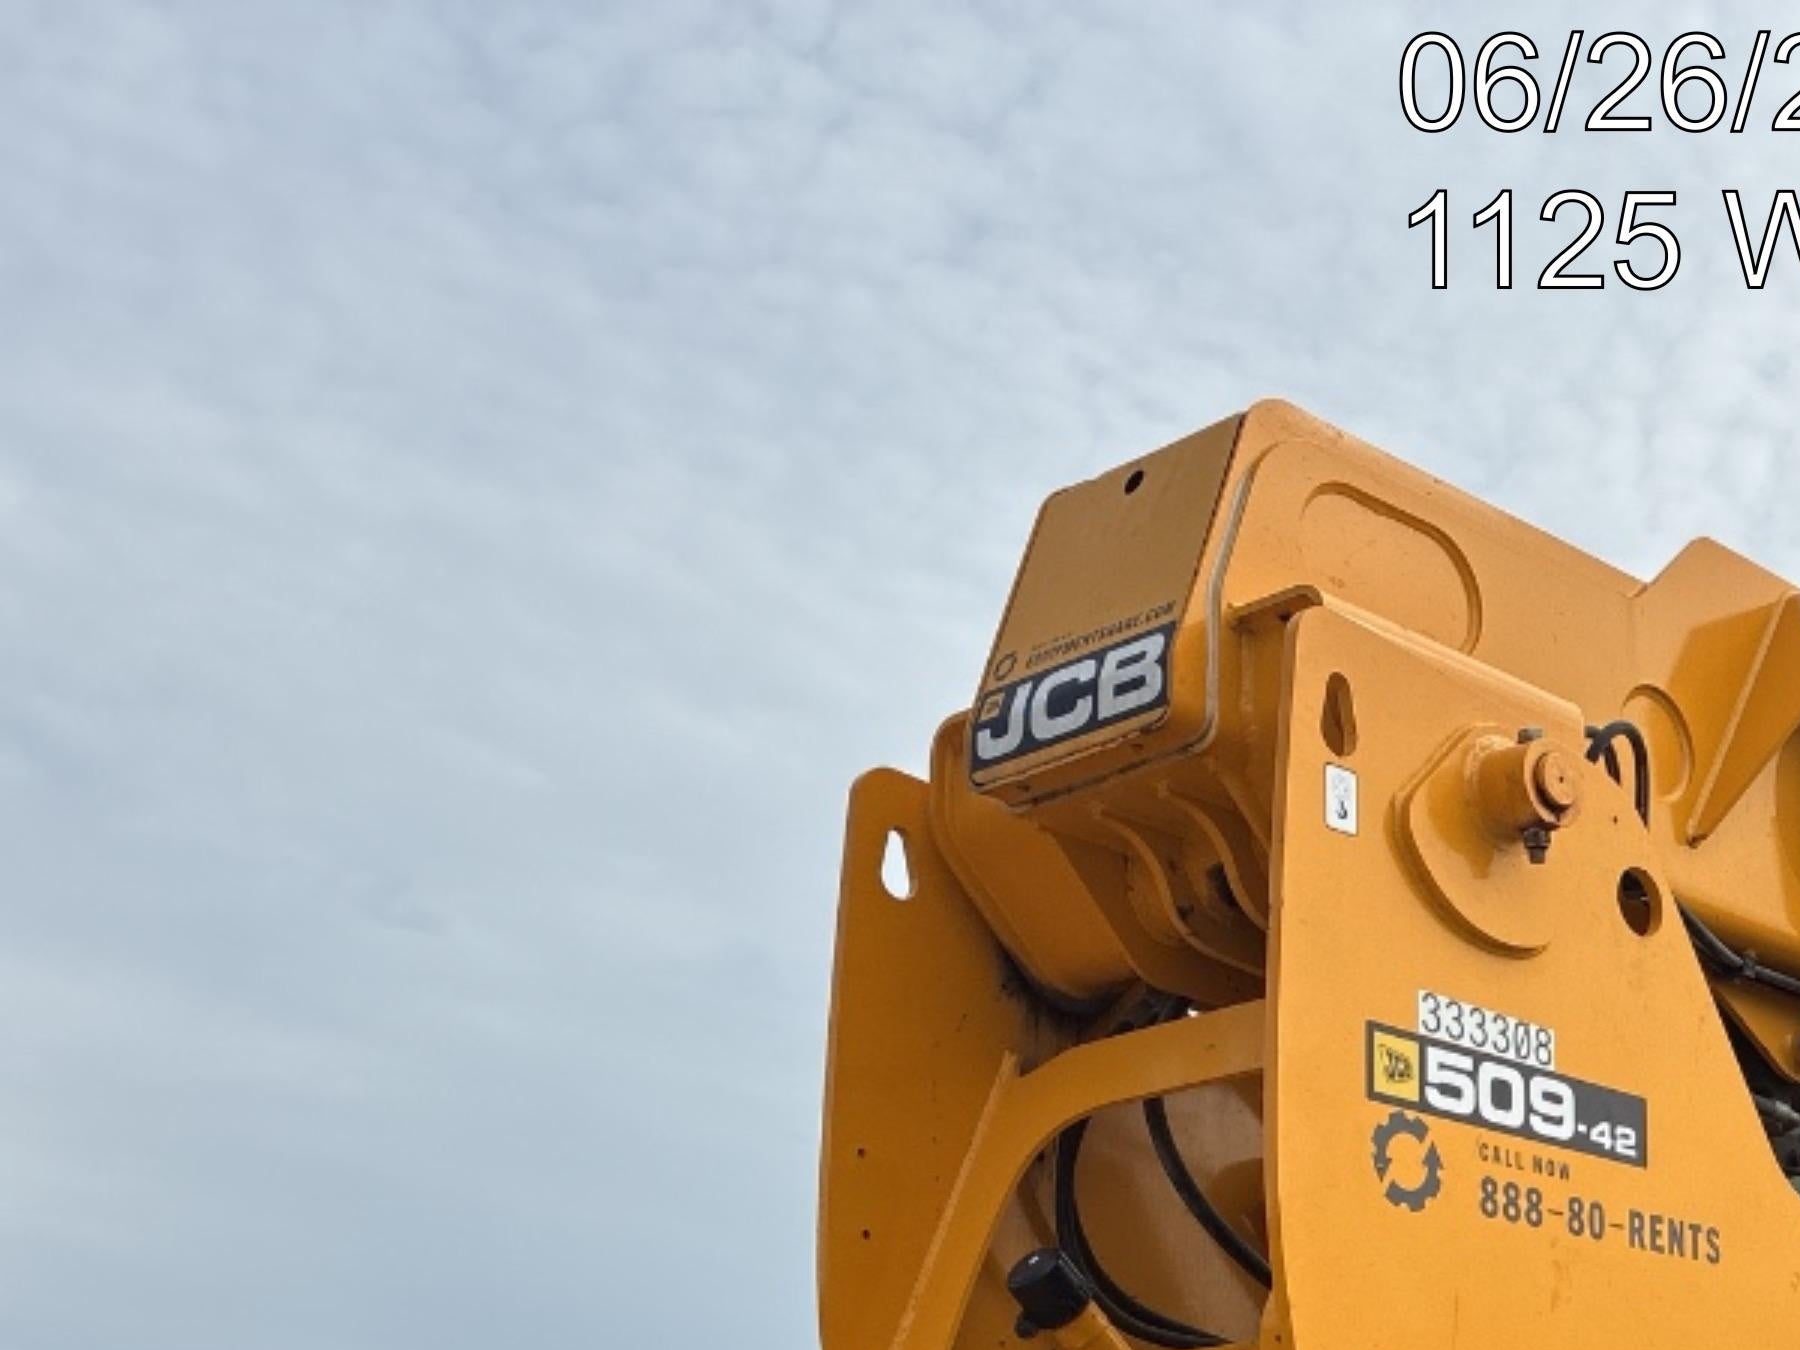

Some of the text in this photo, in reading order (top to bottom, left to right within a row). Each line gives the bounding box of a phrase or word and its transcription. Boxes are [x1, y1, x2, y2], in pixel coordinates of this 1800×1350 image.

[976, 632, 1166, 760] JCB
[1420, 991, 1554, 1068] 333308
[1424, 1045, 1638, 1158] 509-42
[1479, 1142, 1571, 1182] CALL NOW
[1480, 1175, 1722, 1265] 888-80-RENTS
